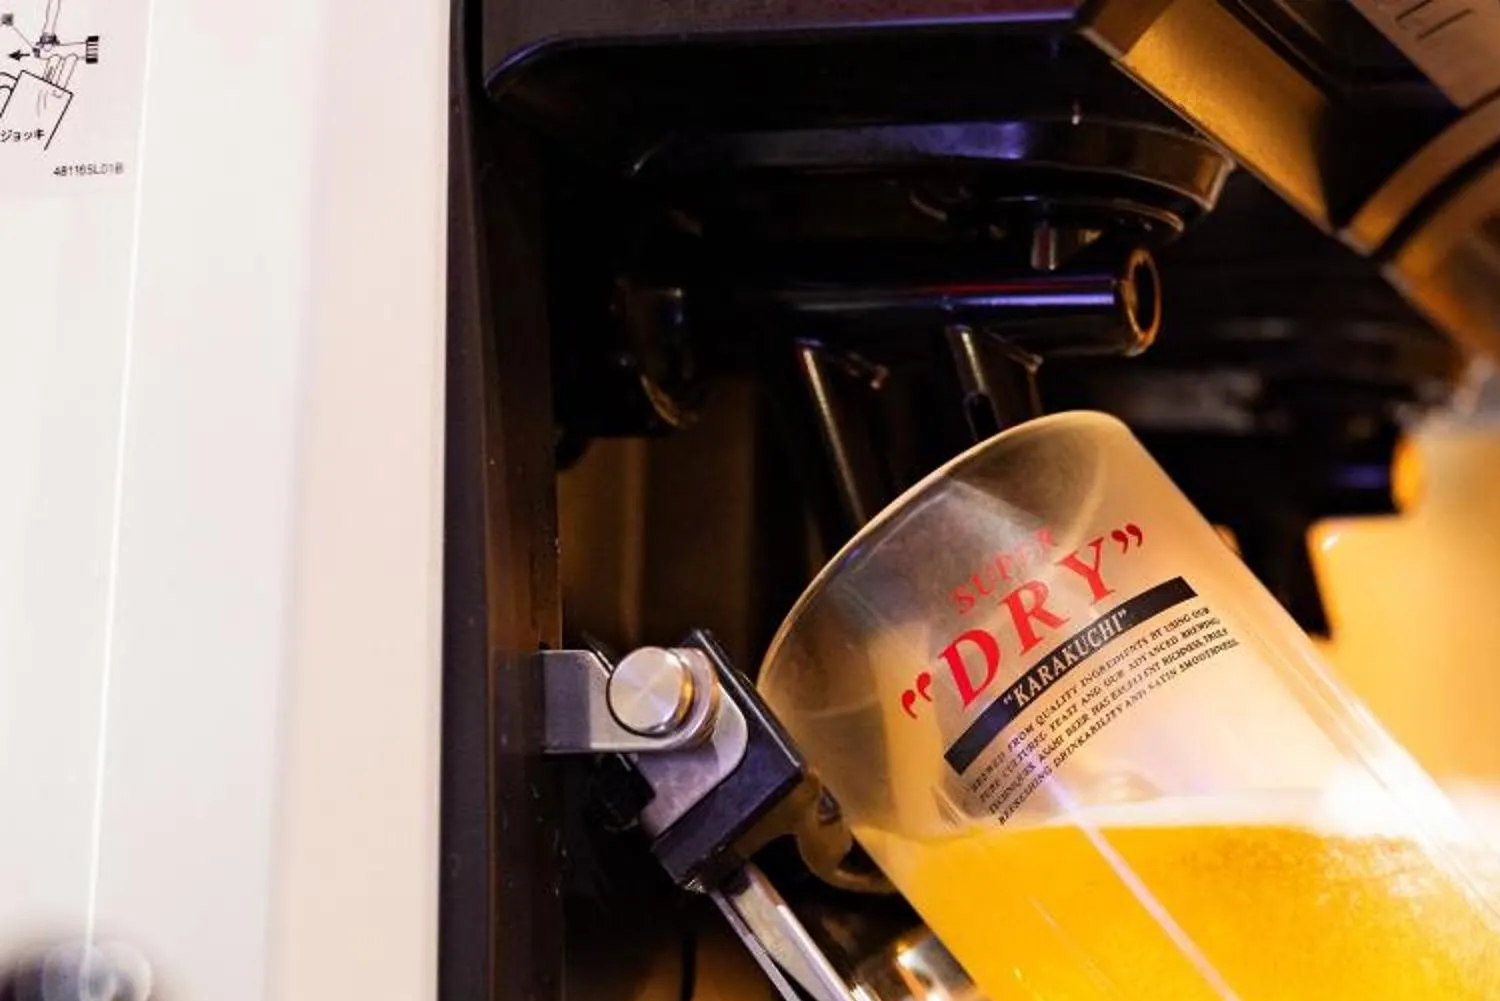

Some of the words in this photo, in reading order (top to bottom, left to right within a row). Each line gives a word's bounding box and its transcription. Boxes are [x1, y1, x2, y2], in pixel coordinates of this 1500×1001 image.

[1035, 684, 1078, 726] QUALITY
[1081, 685, 1102, 706] AND
[1090, 695, 1111, 716] HAS
